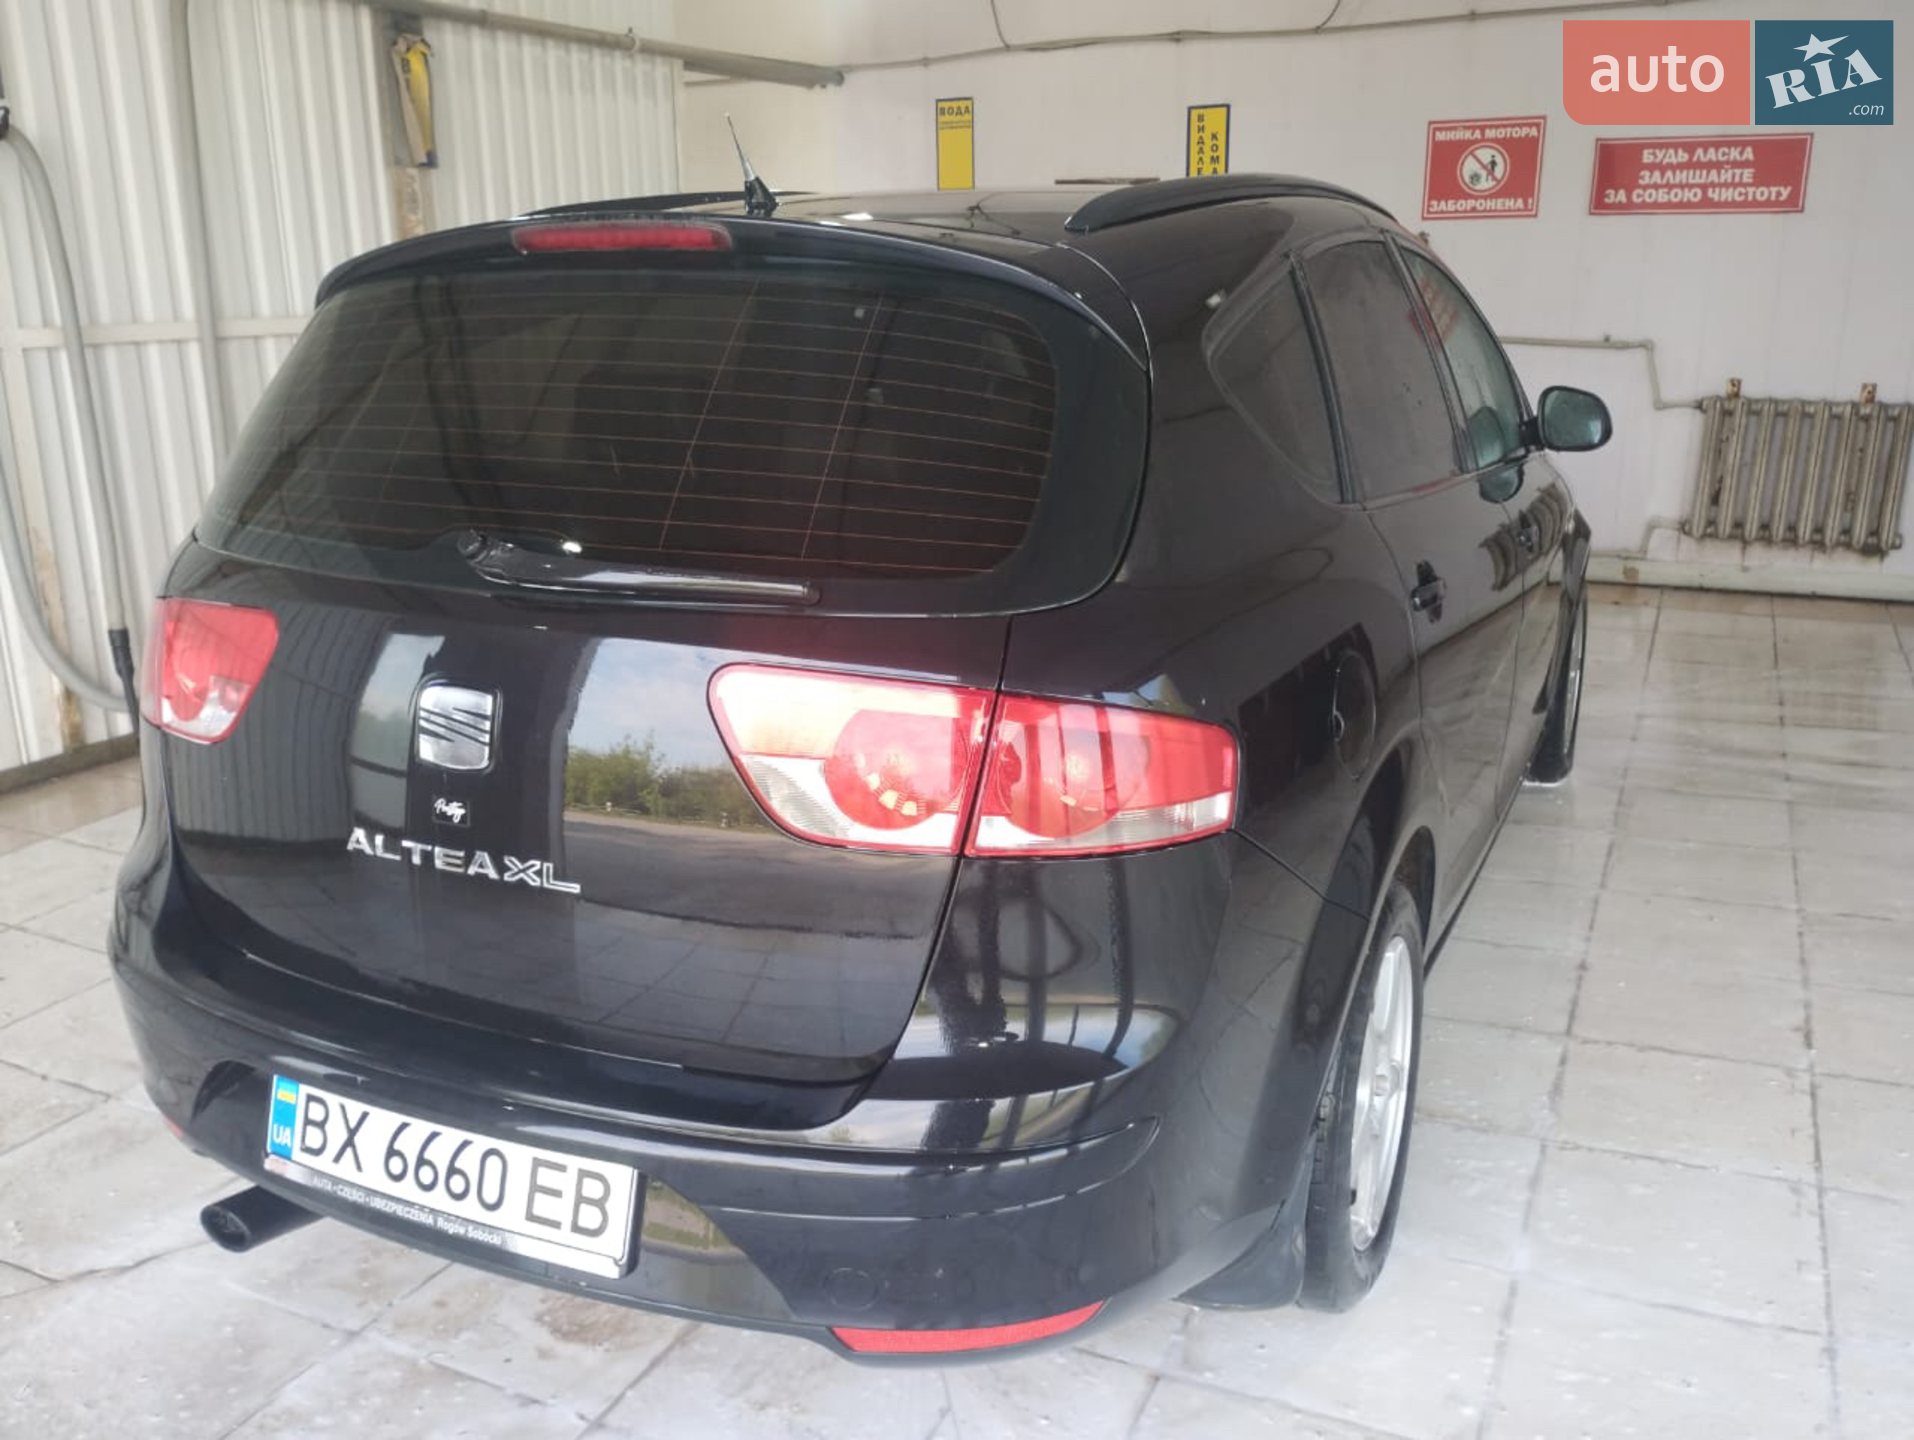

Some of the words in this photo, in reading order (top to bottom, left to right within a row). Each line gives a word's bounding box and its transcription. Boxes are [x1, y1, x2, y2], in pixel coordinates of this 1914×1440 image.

[938, 105, 971, 118] ВОДА
[1434, 127, 1481, 141] МИЙКА
[1484, 126, 1539, 139] МОТОРА
[1642, 148, 1689, 165] БУДЬ
[1693, 146, 1755, 162] ЛАСКА
[1638, 165, 1756, 185] ЗАЛИШАЙТЕ
[1604, 189, 1627, 204] ЗА
[1632, 187, 1702, 203] СОБОЮ
[1707, 186, 1792, 201] ЧИСТОТУ
[1429, 197, 1524, 212] ЗАБОРОНЕНА
[272, 1123, 291, 1149] UA
[300, 1092, 369, 1173] BX
[383, 1121, 508, 1212] 6660
[524, 1155, 612, 1239] EB
